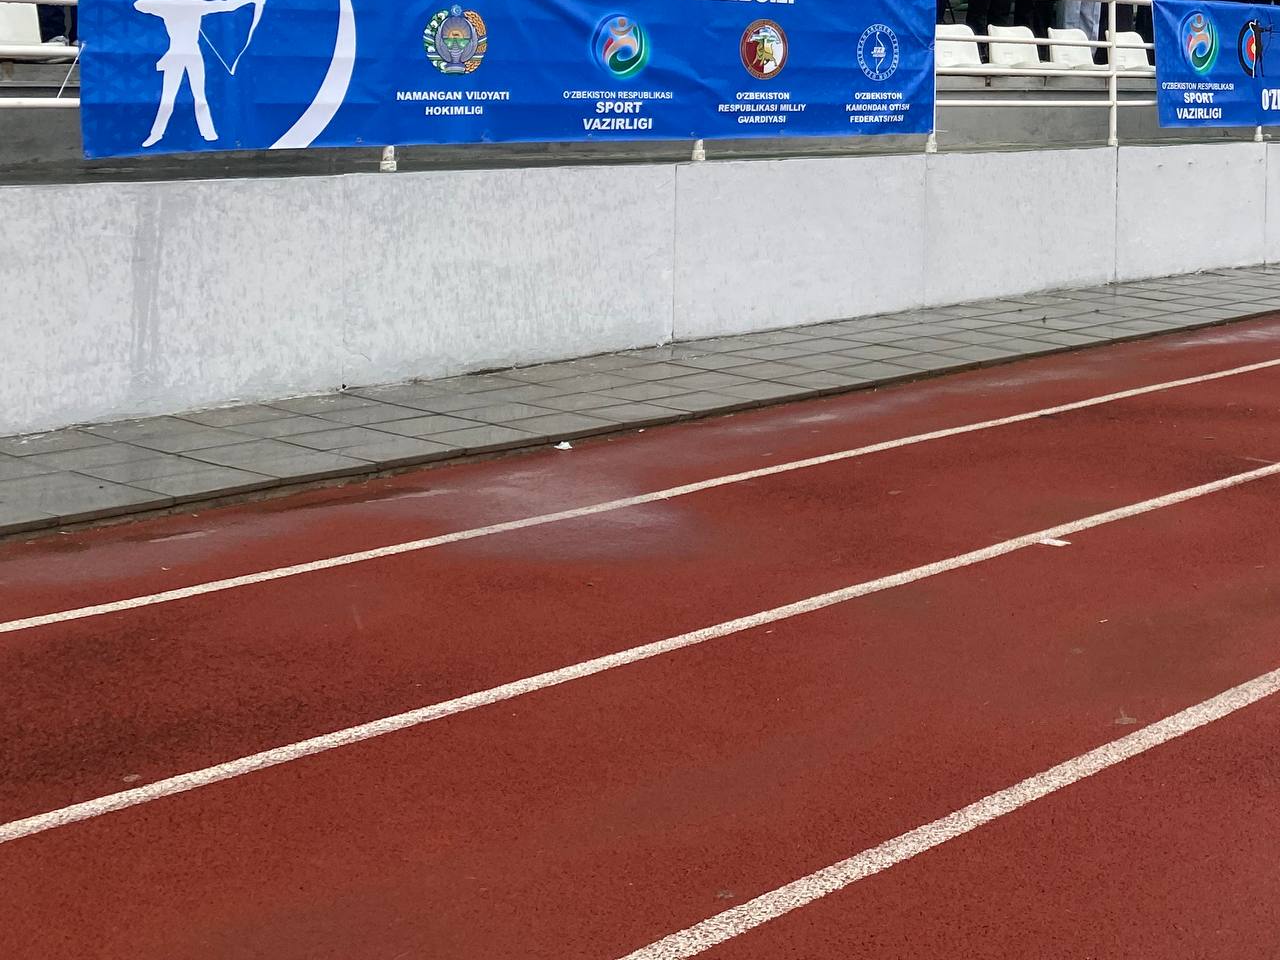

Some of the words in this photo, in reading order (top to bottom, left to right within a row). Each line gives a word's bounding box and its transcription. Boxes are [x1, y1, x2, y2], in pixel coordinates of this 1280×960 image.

[397, 92, 461, 100] NAMANGAN
[466, 91, 509, 100] VILOYATI
[563, 91, 616, 99] O'ZBEKISTON
[618, 91, 673, 99] RESPUBLIKASI
[736, 92, 790, 100] O'ZBEKISTON
[854, 92, 902, 100] O'ZBEKISTON
[1184, 92, 1214, 103] SPORT
[425, 106, 483, 115] HOKIMLIGI
[596, 102, 643, 113] SPORT
[718, 104, 777, 112] RESPUBLIKASI
[1176, 107, 1222, 119] VAZIRLIGI
[738, 115, 786, 123] GVARDIYASI
[850, 115, 904, 123] FEDERATSIYASI
[583, 118, 653, 130] VAZIRLIGI
